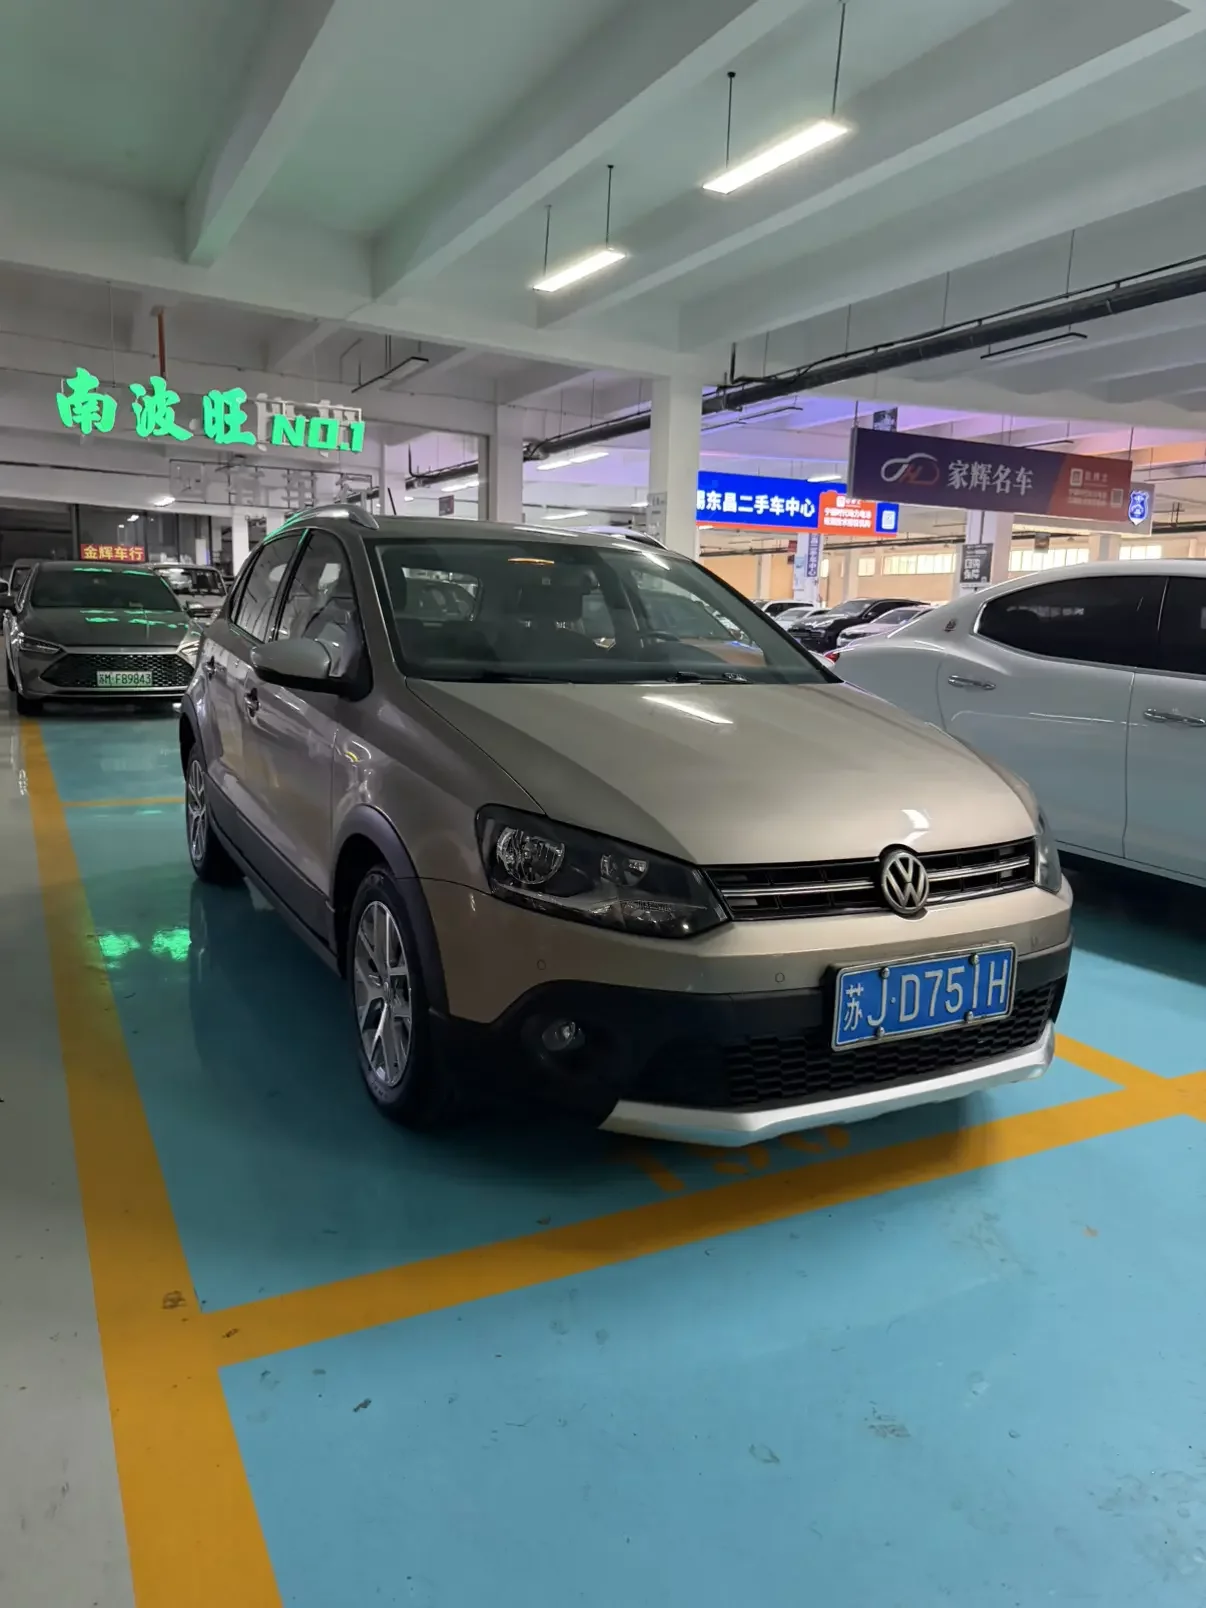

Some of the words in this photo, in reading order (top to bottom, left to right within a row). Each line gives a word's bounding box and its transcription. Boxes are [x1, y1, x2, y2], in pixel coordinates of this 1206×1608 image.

[56, 367, 257, 446] 南波旺
[271, 413, 365, 453] NO.1
[947, 460, 1034, 496] 家辉名车
[83, 545, 143, 561] 金辉车行
